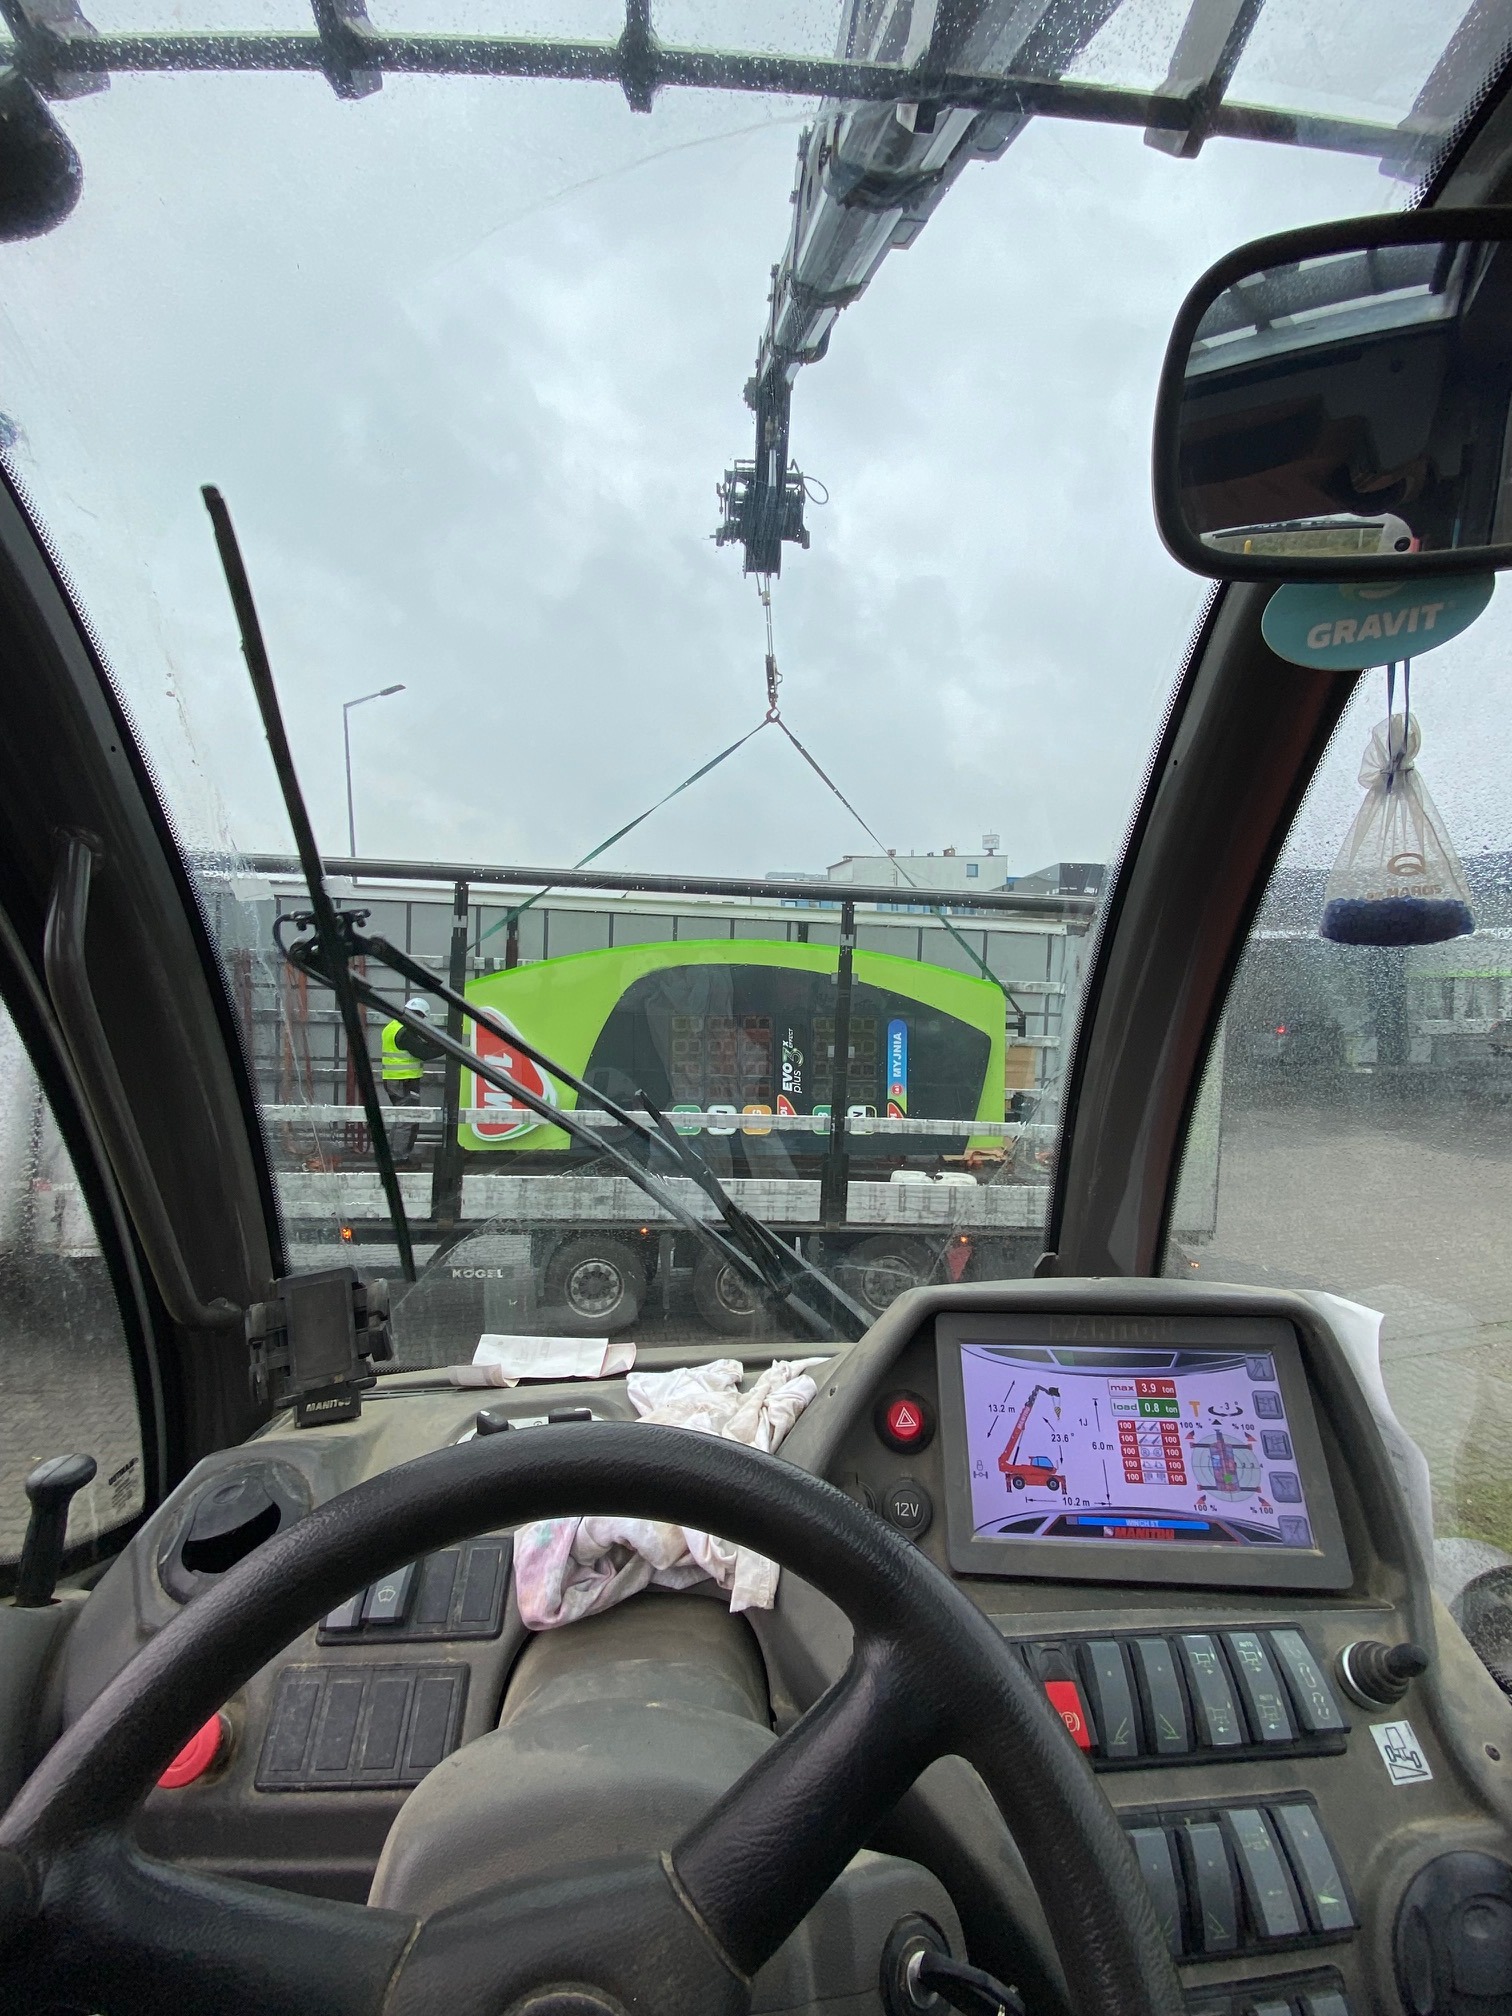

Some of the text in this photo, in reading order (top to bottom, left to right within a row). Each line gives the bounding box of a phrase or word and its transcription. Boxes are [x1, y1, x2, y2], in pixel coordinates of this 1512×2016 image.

[893, 1032, 902, 1078] MYJNIA
[782, 1062, 793, 1092] EVO
[794, 1070, 803, 1094] plus
[1141, 1383, 1157, 1393] 3.9
[988, 1404, 1006, 1413] 13.2
[1113, 1402, 1137, 1411] load
[1144, 1402, 1160, 1413] 0.8
[1092, 1442, 1105, 1450] 6.0
[1062, 1497, 1081, 1506] 10.2
[895, 1502, 919, 1517] 12V
[1115, 1527, 1174, 1540] MANITOU
